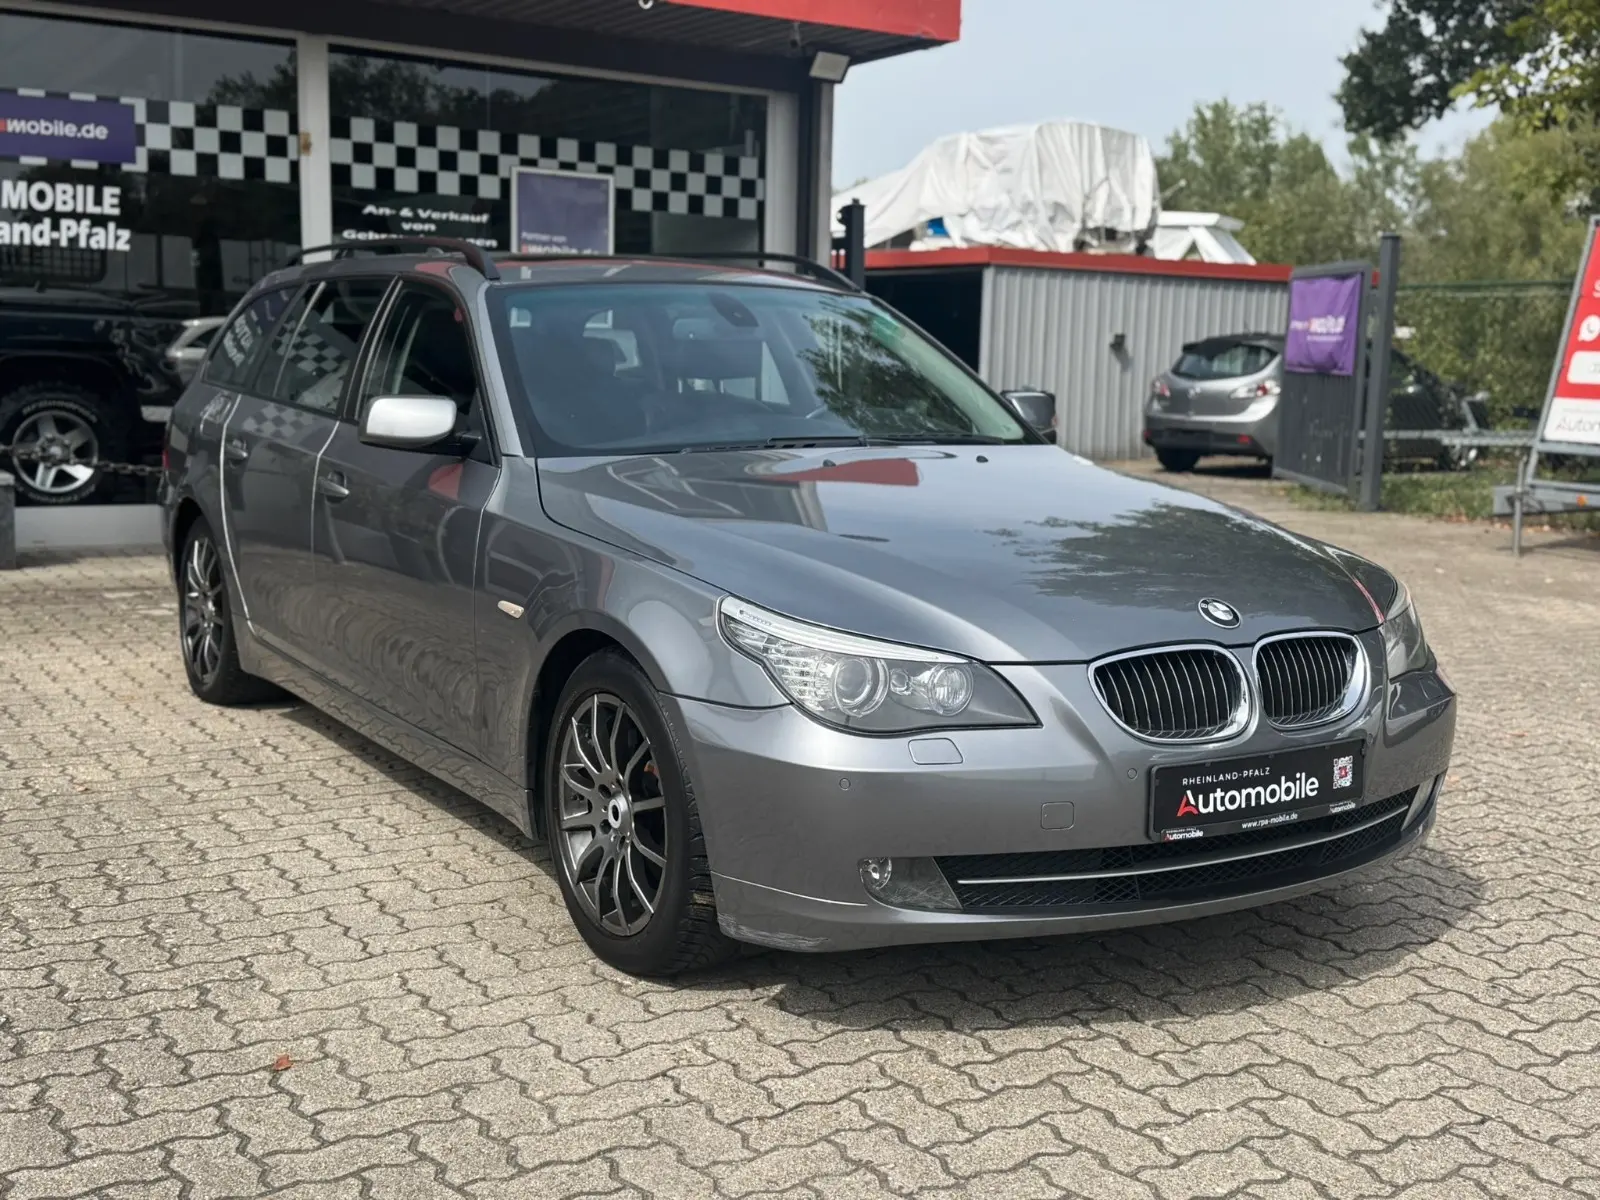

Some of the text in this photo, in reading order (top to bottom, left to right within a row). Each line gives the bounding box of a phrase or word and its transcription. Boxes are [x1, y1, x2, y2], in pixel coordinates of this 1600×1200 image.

[6, 118, 108, 140] mobile.de
[1, 179, 121, 215] MOBILE
[400, 207, 413, 218] &
[417, 208, 490, 224] Verkauf
[0, 217, 131, 251] and-Pfalz
[401, 221, 437, 232] von
[1182, 767, 1271, 786] RHEINLAND-PFALZ
[1176, 772, 1320, 817] Automobile
[1241, 812, 1298, 829] www.rpa-mobile.de
[1164, 829, 1204, 841] Automobile
